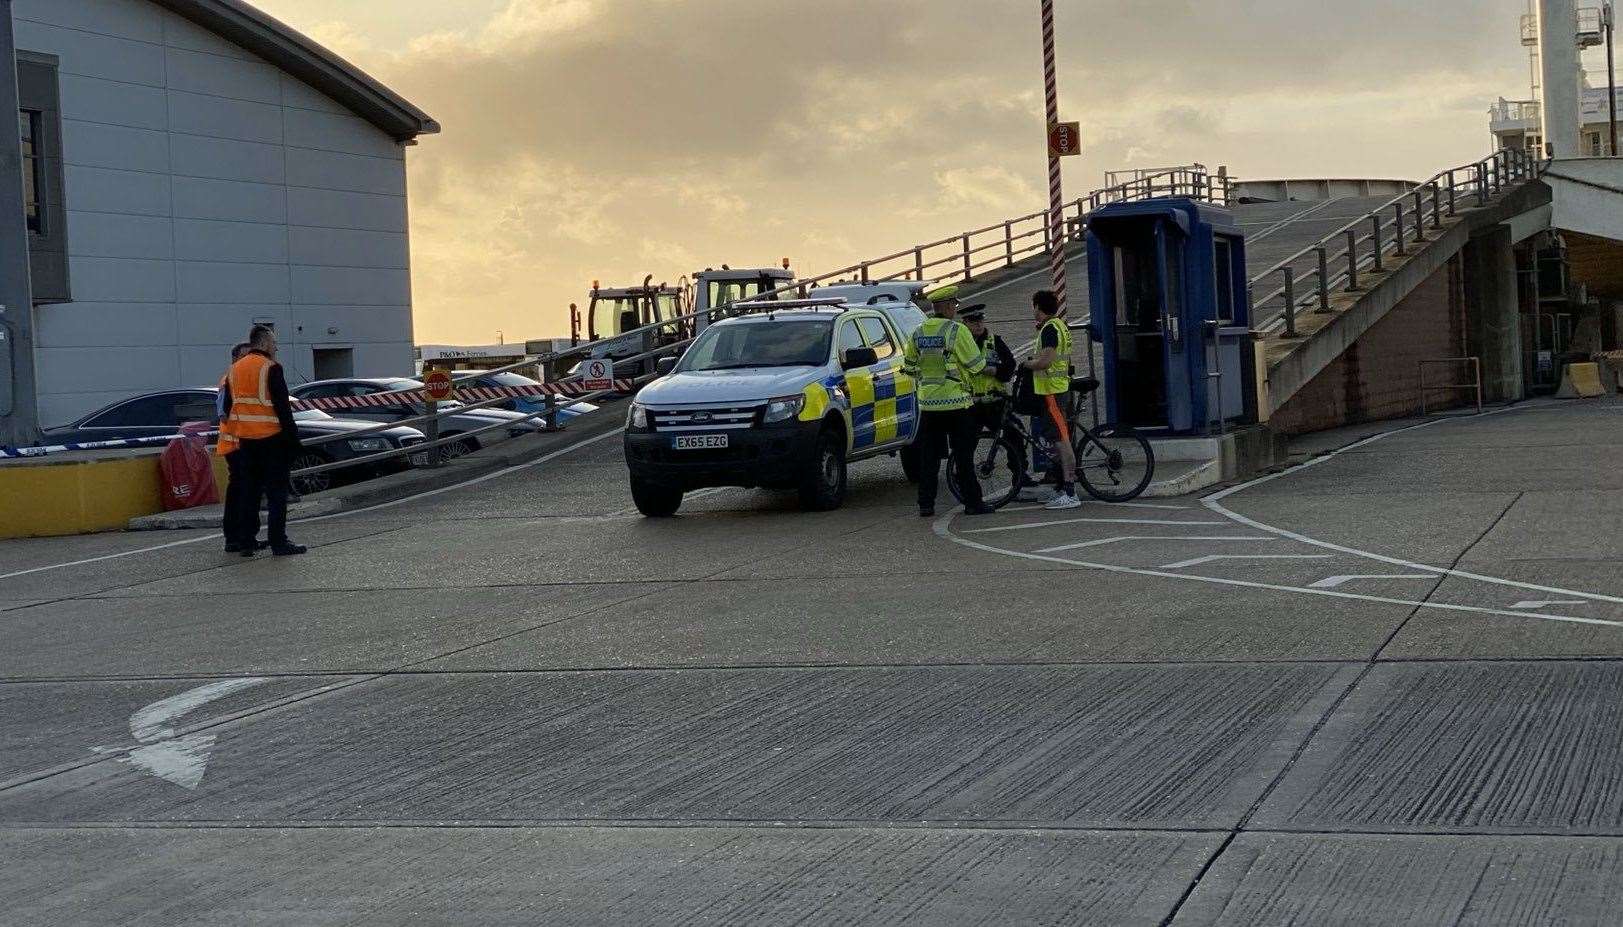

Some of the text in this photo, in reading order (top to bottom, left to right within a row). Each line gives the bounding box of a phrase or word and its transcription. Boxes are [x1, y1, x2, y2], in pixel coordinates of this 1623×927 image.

[1059, 126, 1069, 153] STOP
[918, 337, 944, 347] POLICE
[427, 382, 449, 391] STOP
[678, 436, 726, 448] EX65 EZG
